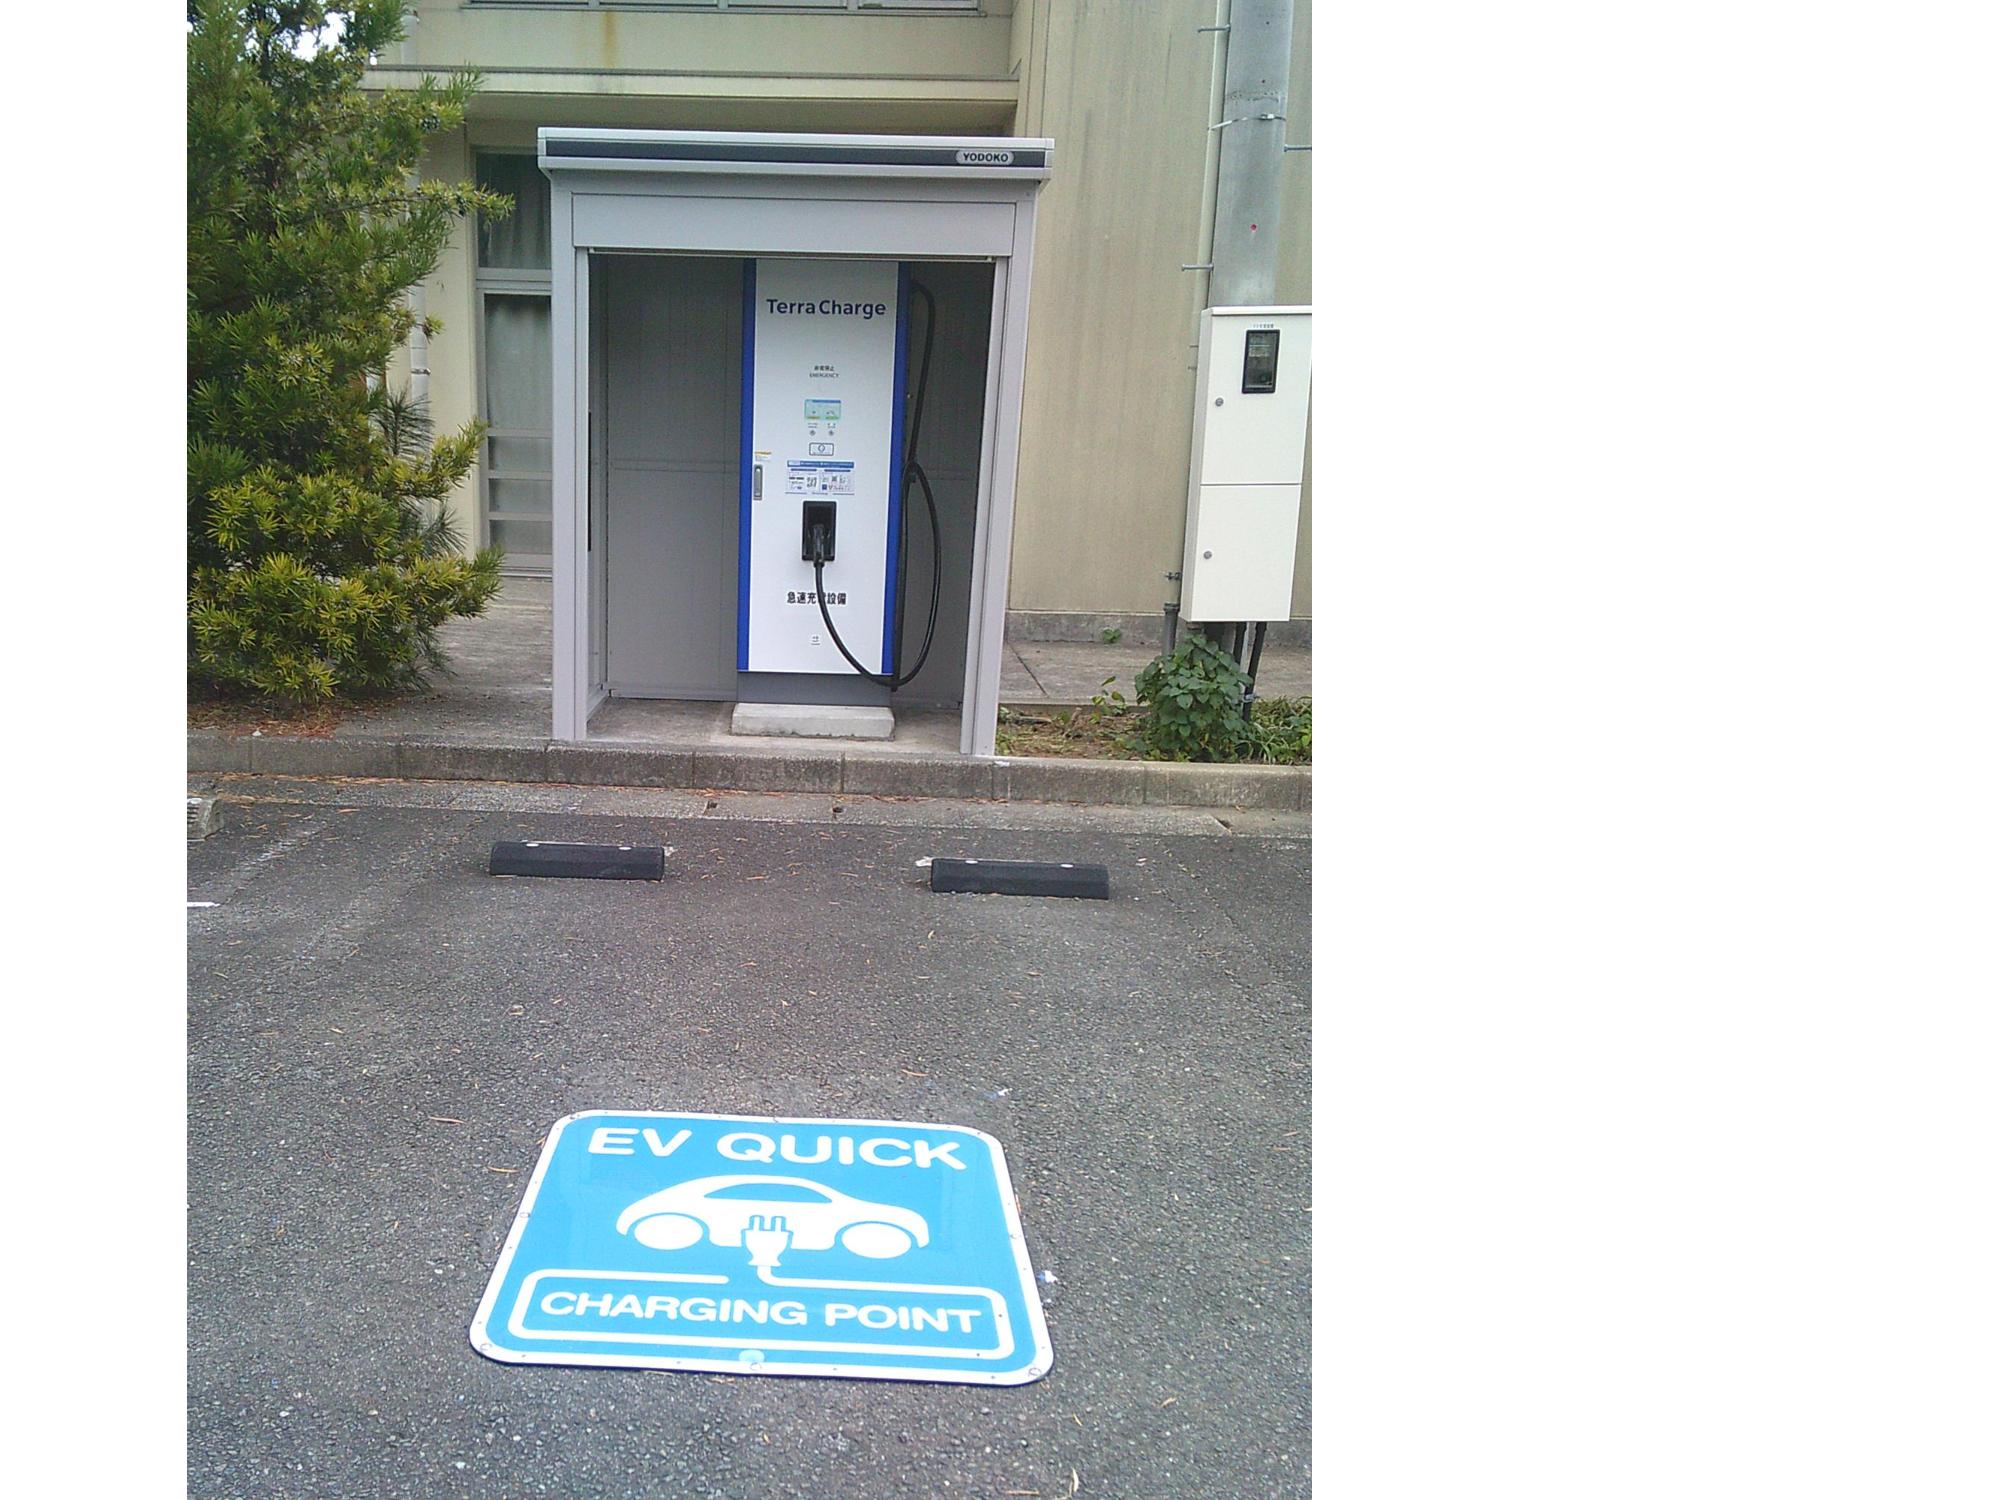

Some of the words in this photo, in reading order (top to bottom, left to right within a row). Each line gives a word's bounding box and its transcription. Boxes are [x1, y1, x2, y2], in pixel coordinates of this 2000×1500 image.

[963, 152, 1009, 163] YODOKO
[766, 299, 815, 315] Terra
[819, 300, 886, 320] Charge
[787, 591, 847, 605] 急速充設備
[588, 1127, 692, 1157] EV
[716, 1132, 966, 1170] QUICK
[541, 1291, 807, 1326] CHARGING
[825, 1303, 981, 1333] POINT
